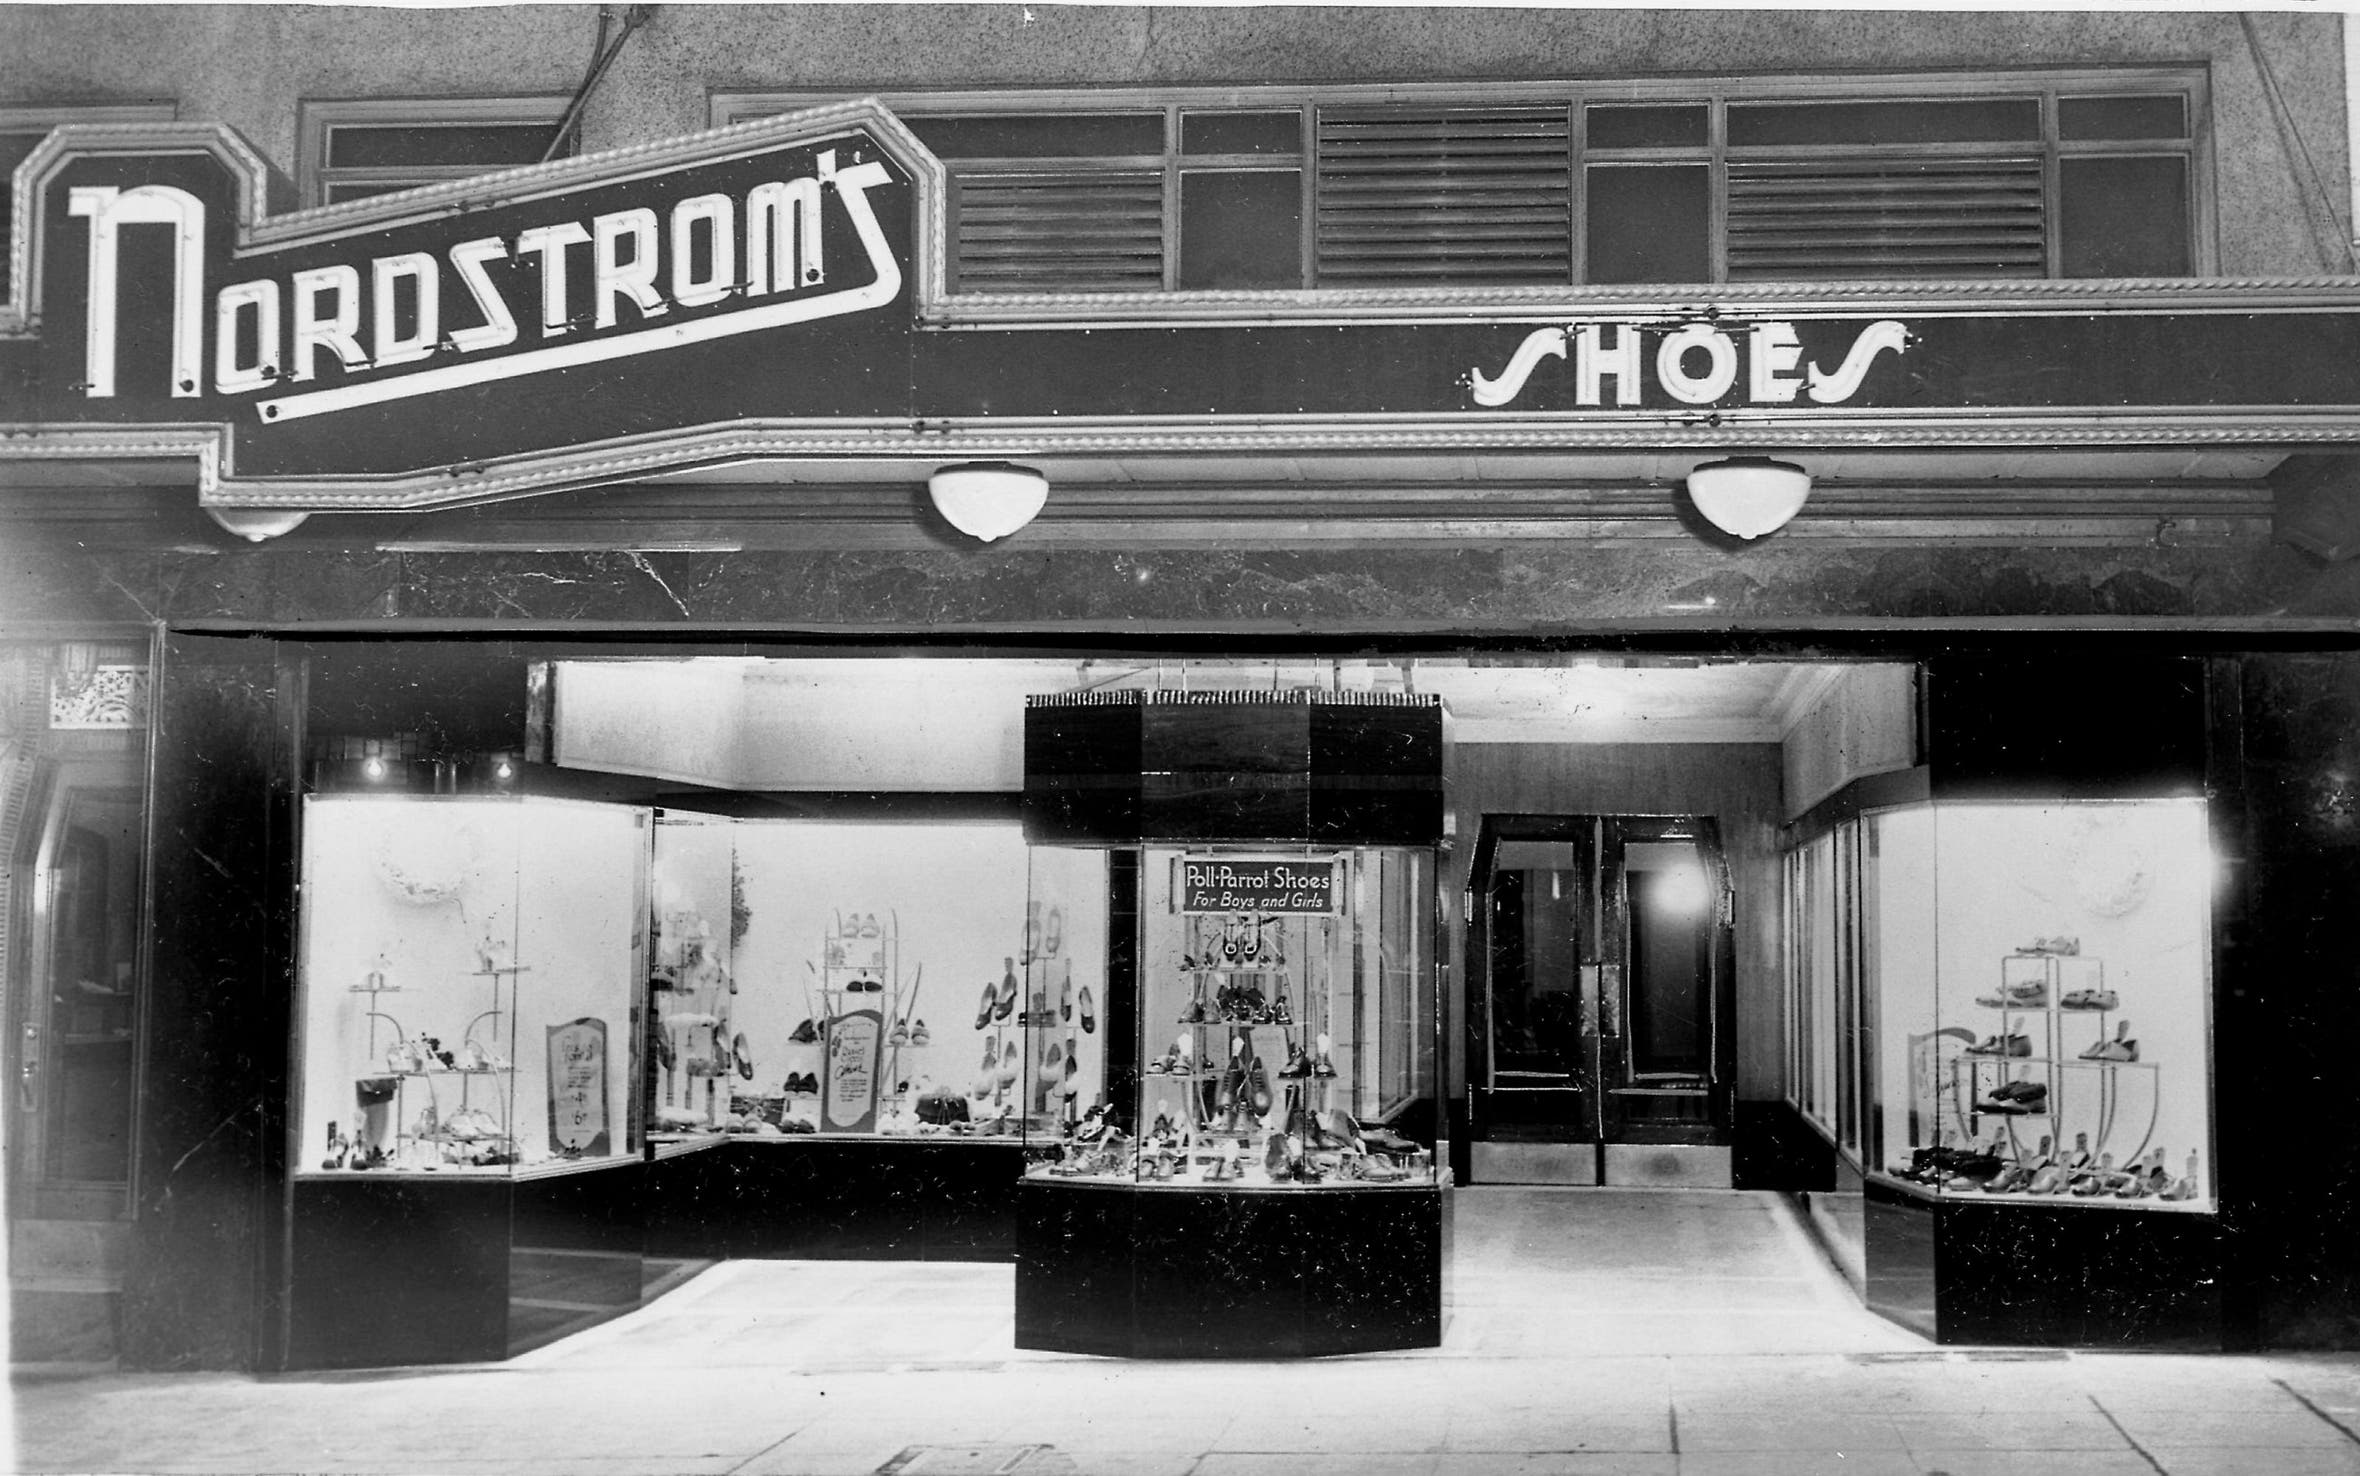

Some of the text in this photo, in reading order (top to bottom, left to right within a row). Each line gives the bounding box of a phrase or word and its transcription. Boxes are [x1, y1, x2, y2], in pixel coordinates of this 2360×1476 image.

[1472, 319, 1907, 406] SHOES
[1274, 867, 1330, 889] Shoes
[1193, 891, 1323, 909] For Boys and Girls
